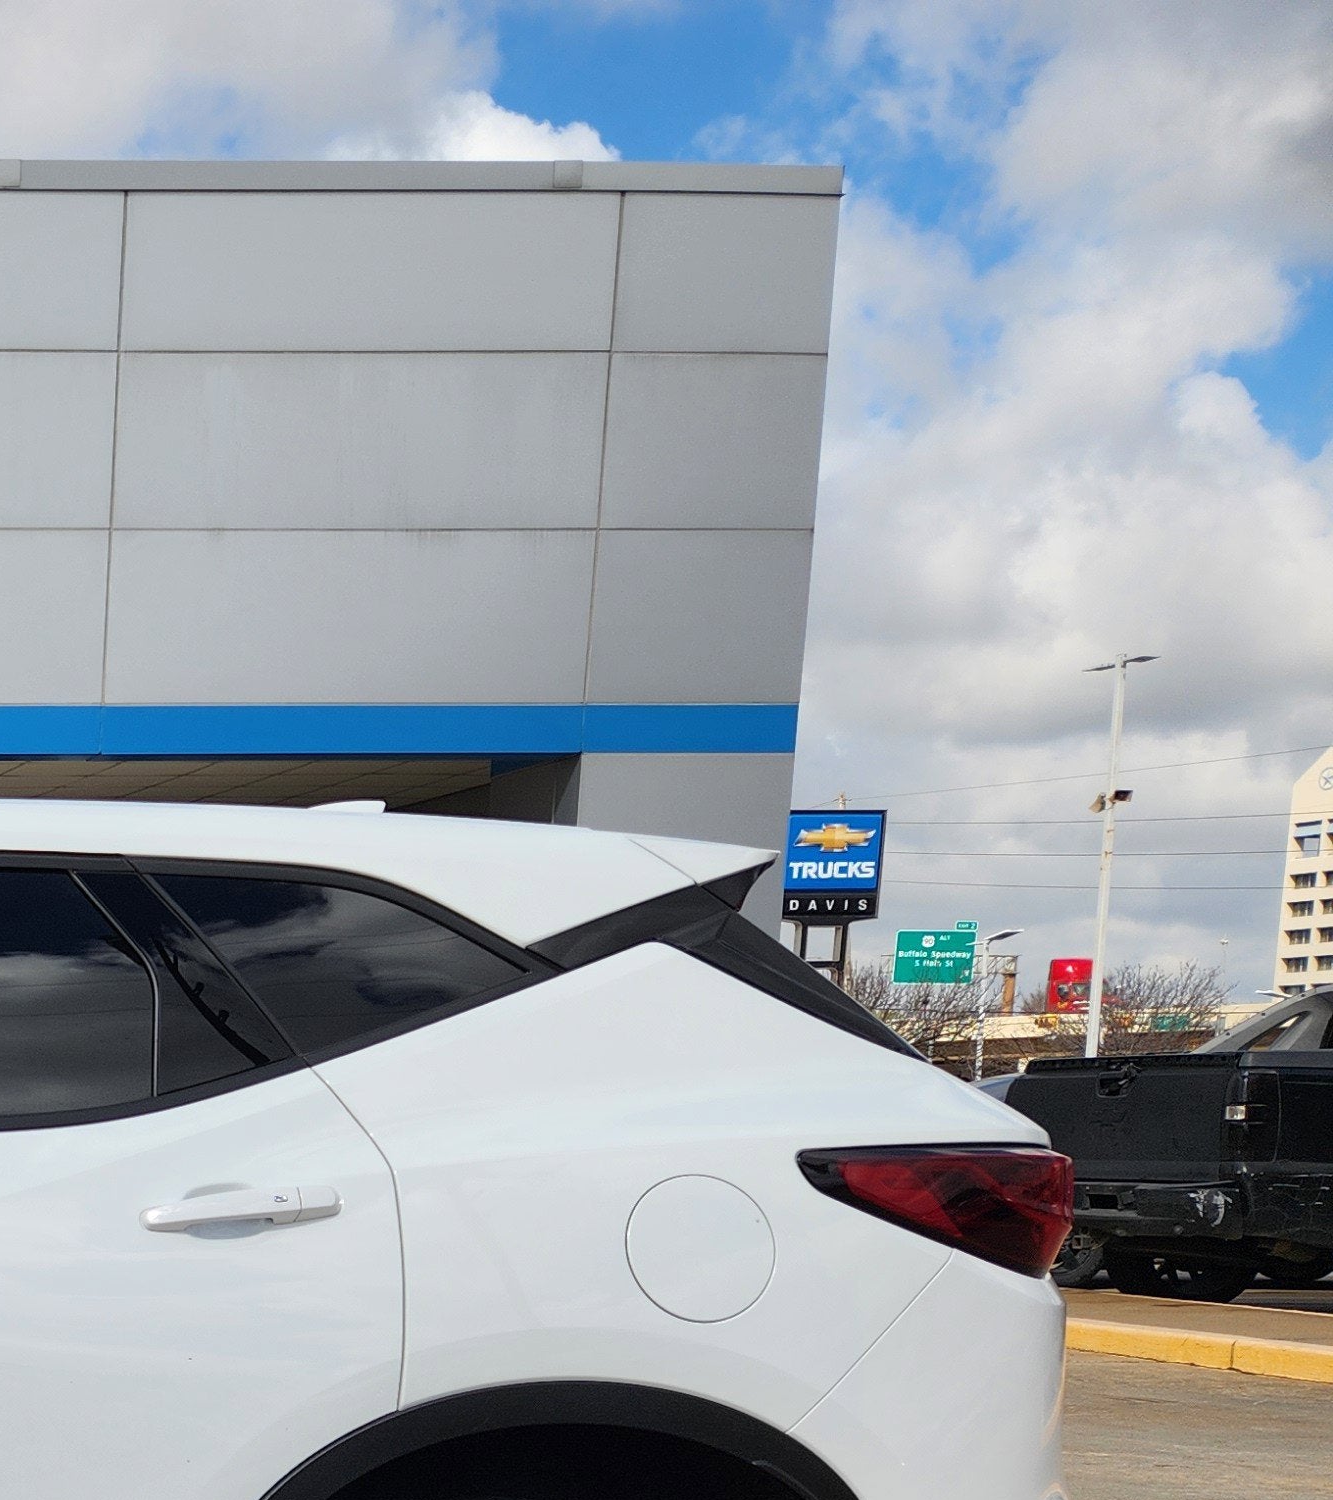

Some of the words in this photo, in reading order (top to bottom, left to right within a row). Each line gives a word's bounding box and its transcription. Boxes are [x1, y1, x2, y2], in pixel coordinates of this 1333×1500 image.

[789, 861, 876, 879] TRUCKS
[789, 899, 868, 911] DAVIS
[924, 937, 934, 946] 90
[898, 950, 928, 958] Buffalo
[931, 950, 972, 959] Speedway
[945, 960, 954, 968] St
